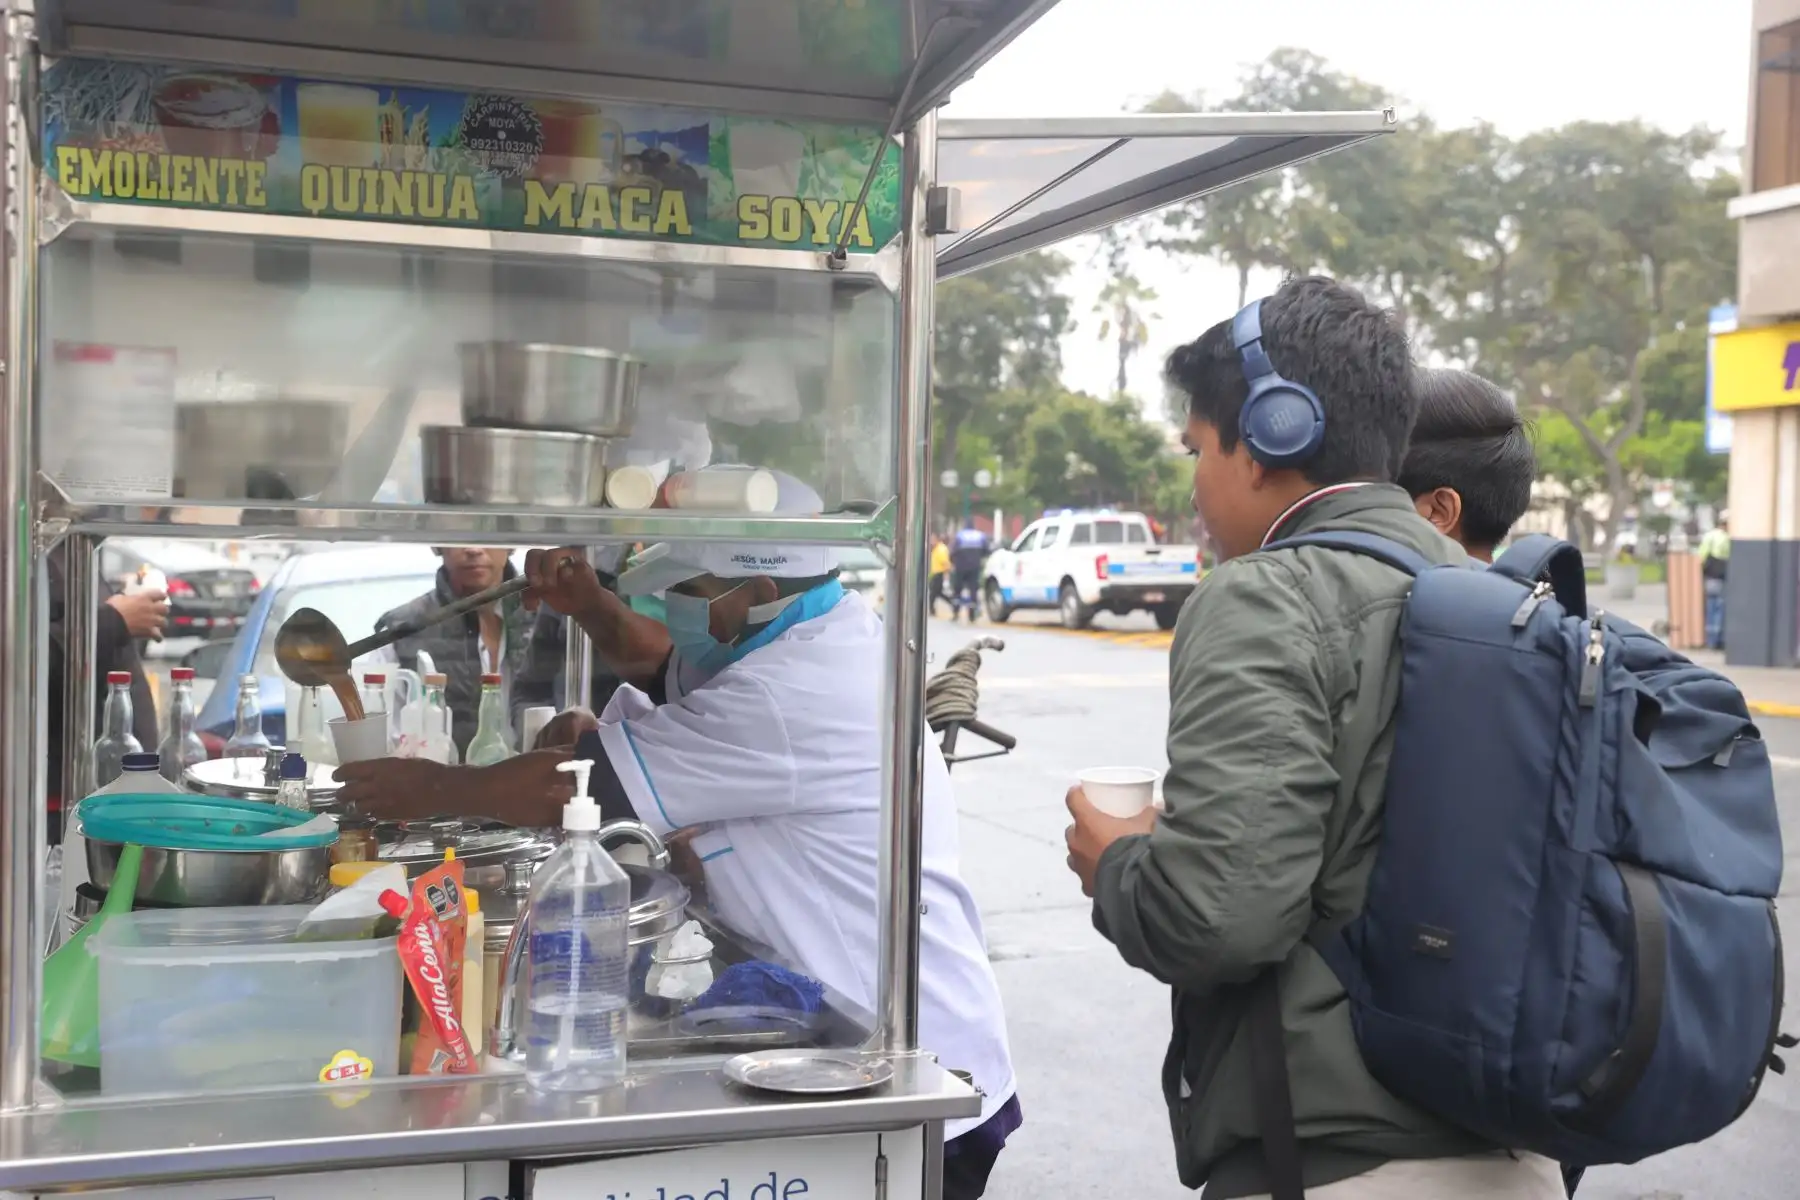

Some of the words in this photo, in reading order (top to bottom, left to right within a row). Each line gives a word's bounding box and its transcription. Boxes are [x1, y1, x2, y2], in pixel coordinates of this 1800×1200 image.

[488, 117, 515, 129] MOYA
[56, 145, 268, 207] EMOLIENTE
[300, 163, 480, 220] QUINUA
[523, 179, 692, 236] MACA
[737, 194, 875, 248] SOYA
[731, 554, 757, 565] JESÚS
[760, 555, 788, 565] MARÍA
[750, 1171, 809, 1200] de
